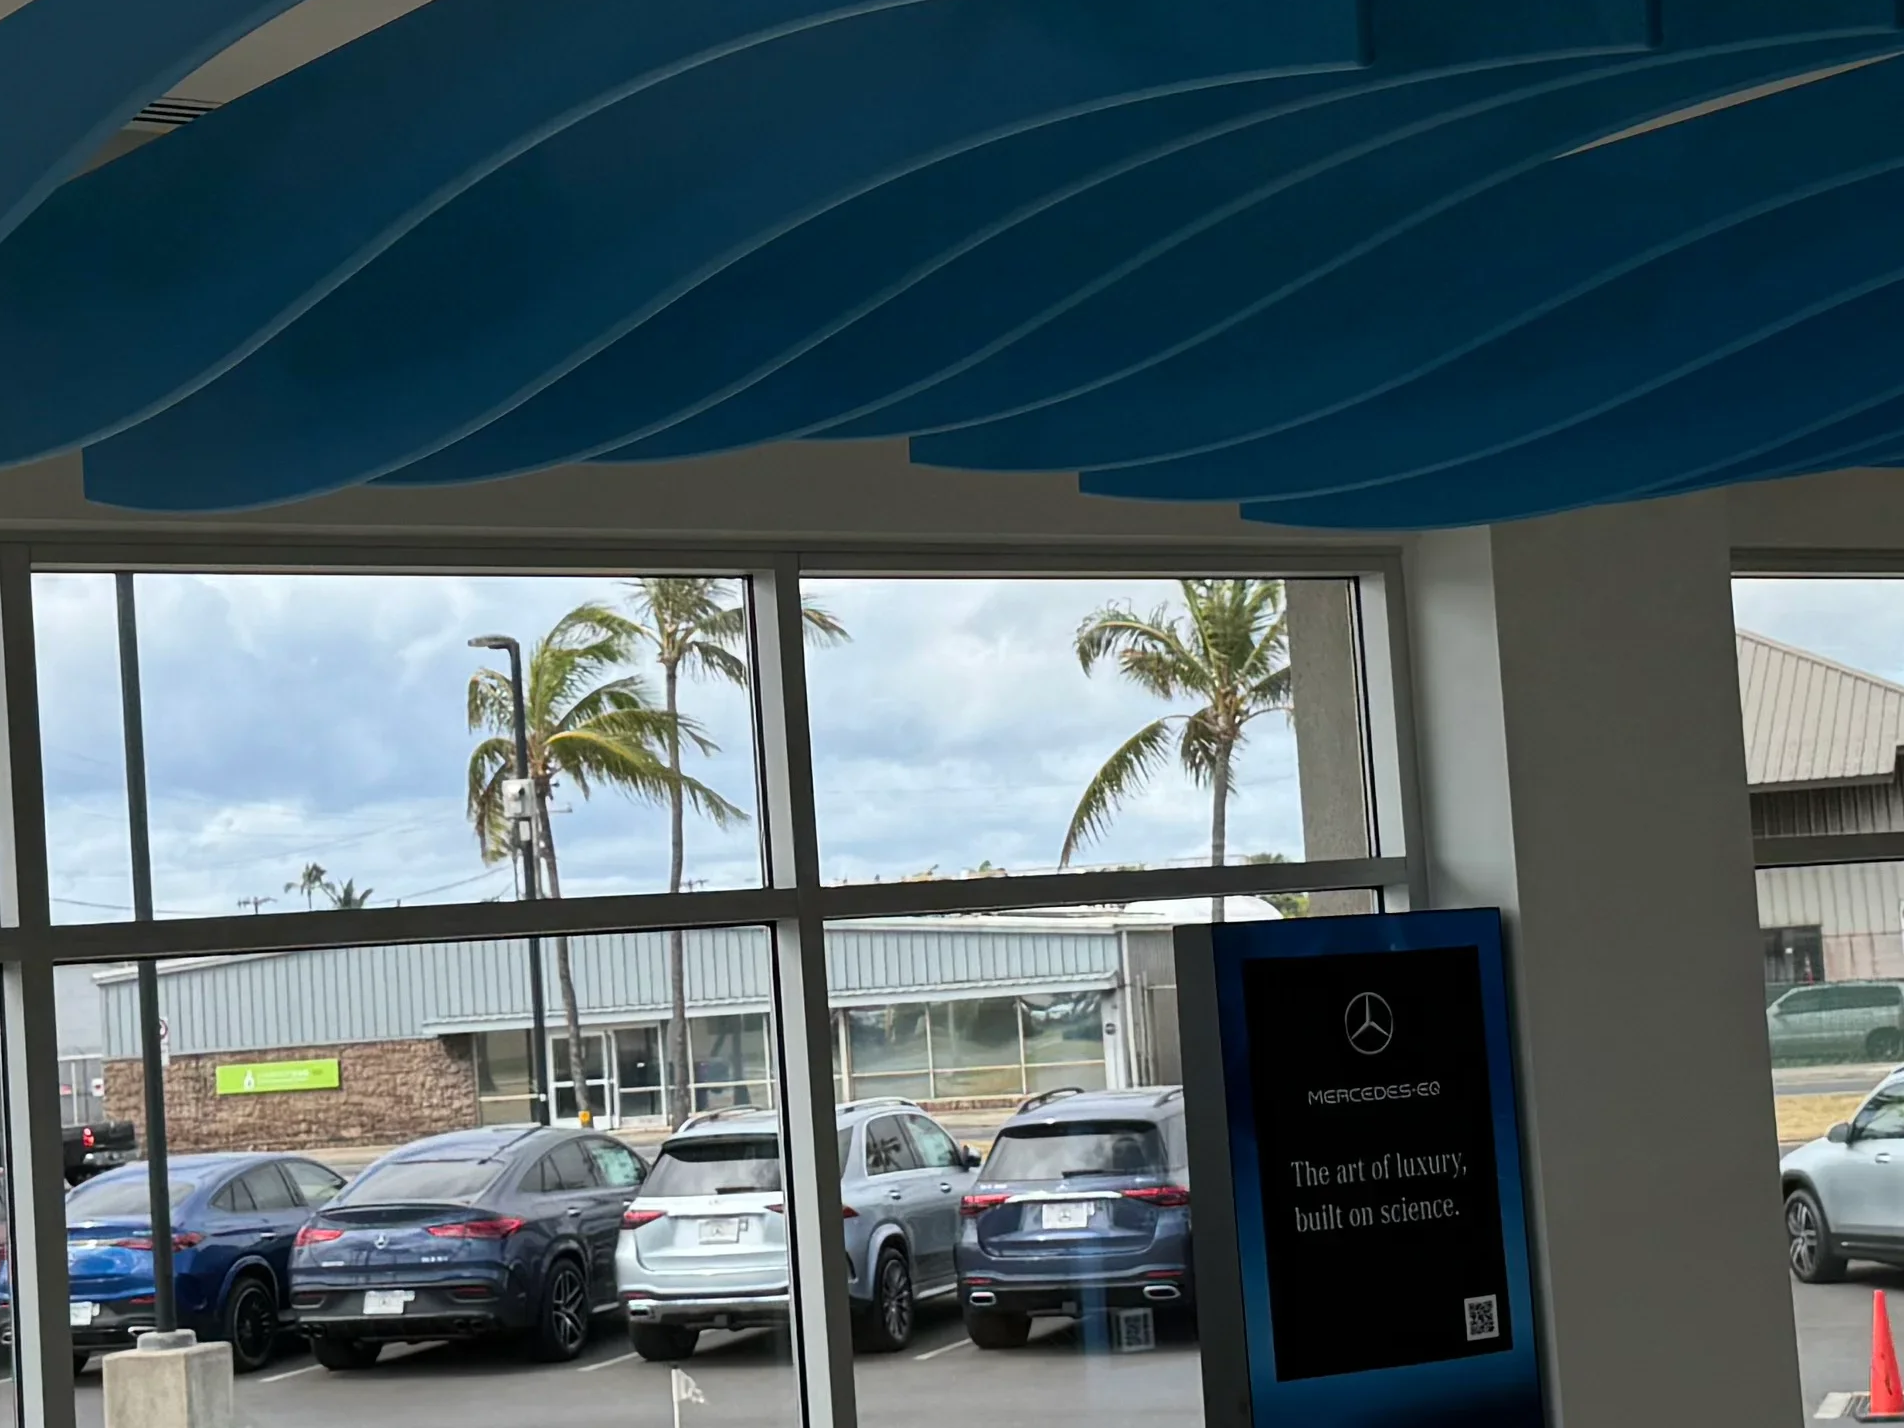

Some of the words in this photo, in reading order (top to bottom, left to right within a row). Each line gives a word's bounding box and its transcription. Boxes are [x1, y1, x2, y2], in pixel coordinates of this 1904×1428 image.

[1291, 1160, 1330, 1187] The
[1337, 1158, 1366, 1184] art
[1372, 1153, 1391, 1181] of
[1396, 1152, 1467, 1179] luxury,
[1295, 1203, 1343, 1232] built
[1349, 1204, 1373, 1227] on
[1381, 1197, 1460, 1224] science.
